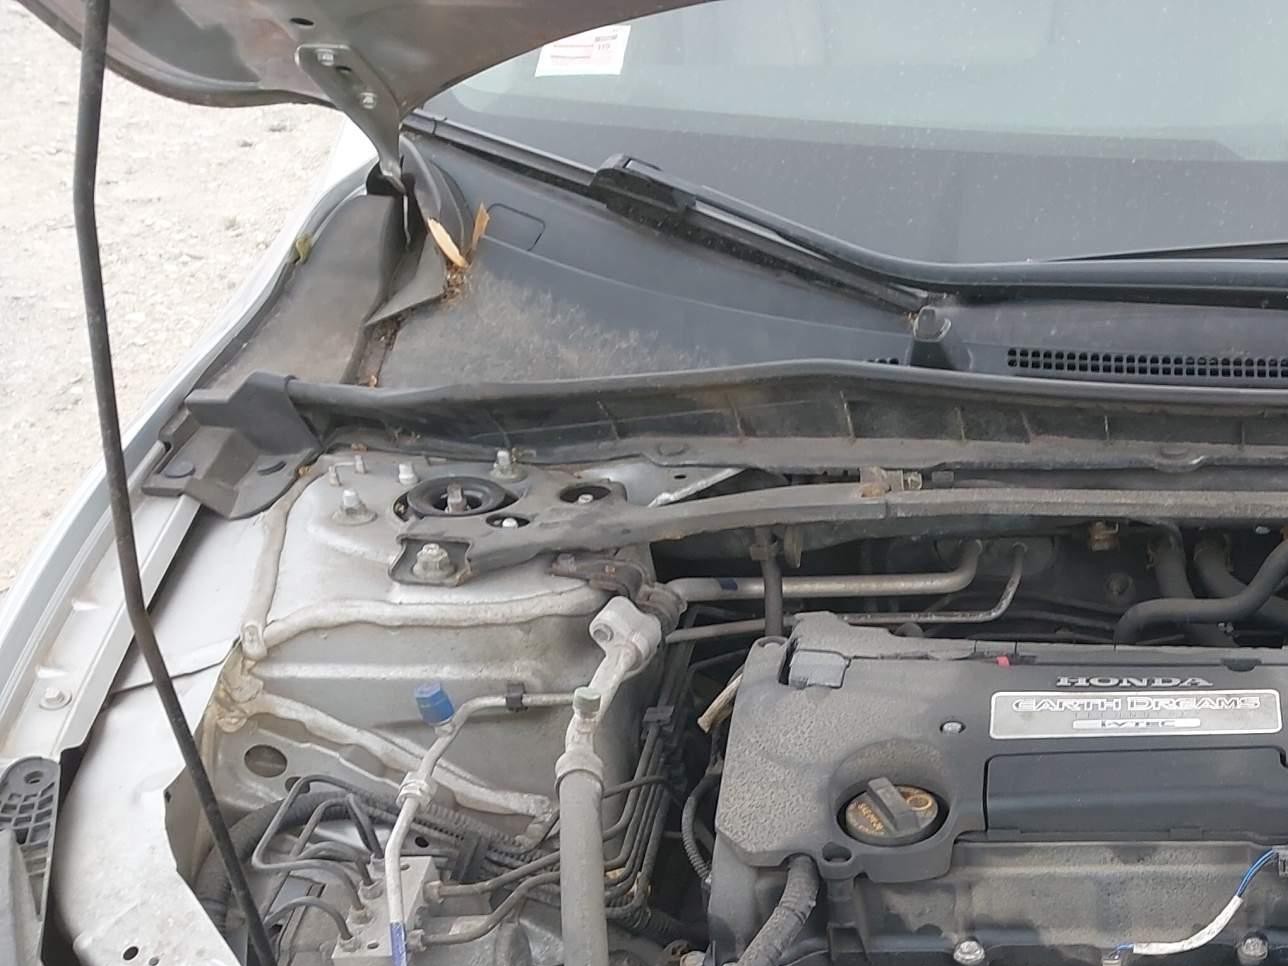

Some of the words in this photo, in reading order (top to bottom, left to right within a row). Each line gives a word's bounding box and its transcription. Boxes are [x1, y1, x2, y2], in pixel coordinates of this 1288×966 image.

[1055, 675, 1214, 688] HONDA
[1012, 697, 1122, 712] EARTH
[1127, 695, 1261, 711] DREAMS
